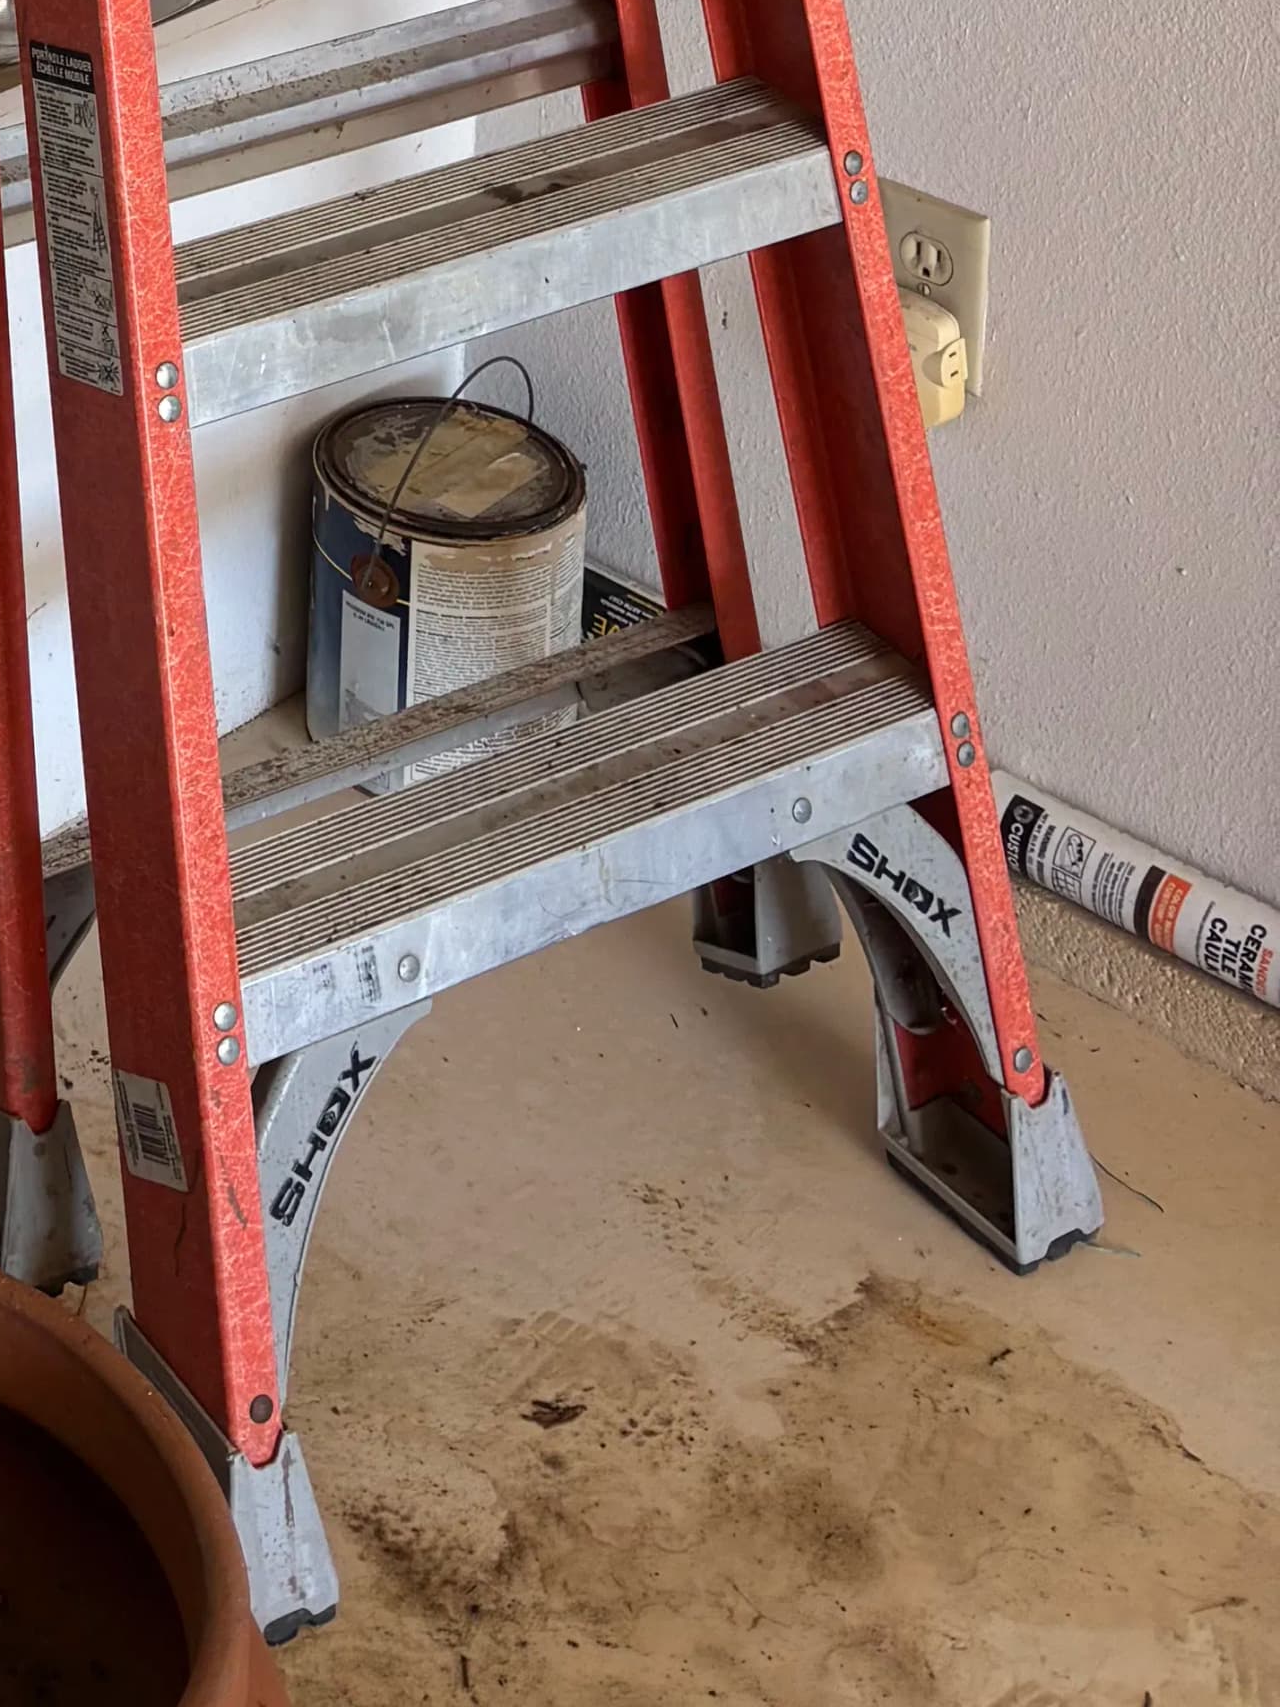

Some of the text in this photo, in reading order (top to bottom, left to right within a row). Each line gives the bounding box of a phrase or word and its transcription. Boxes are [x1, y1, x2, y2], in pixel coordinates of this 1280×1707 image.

[846, 832, 963, 937] SHOX
[1221, 938, 1240, 977] TILE
[256, 1042, 390, 1225] SHOX
